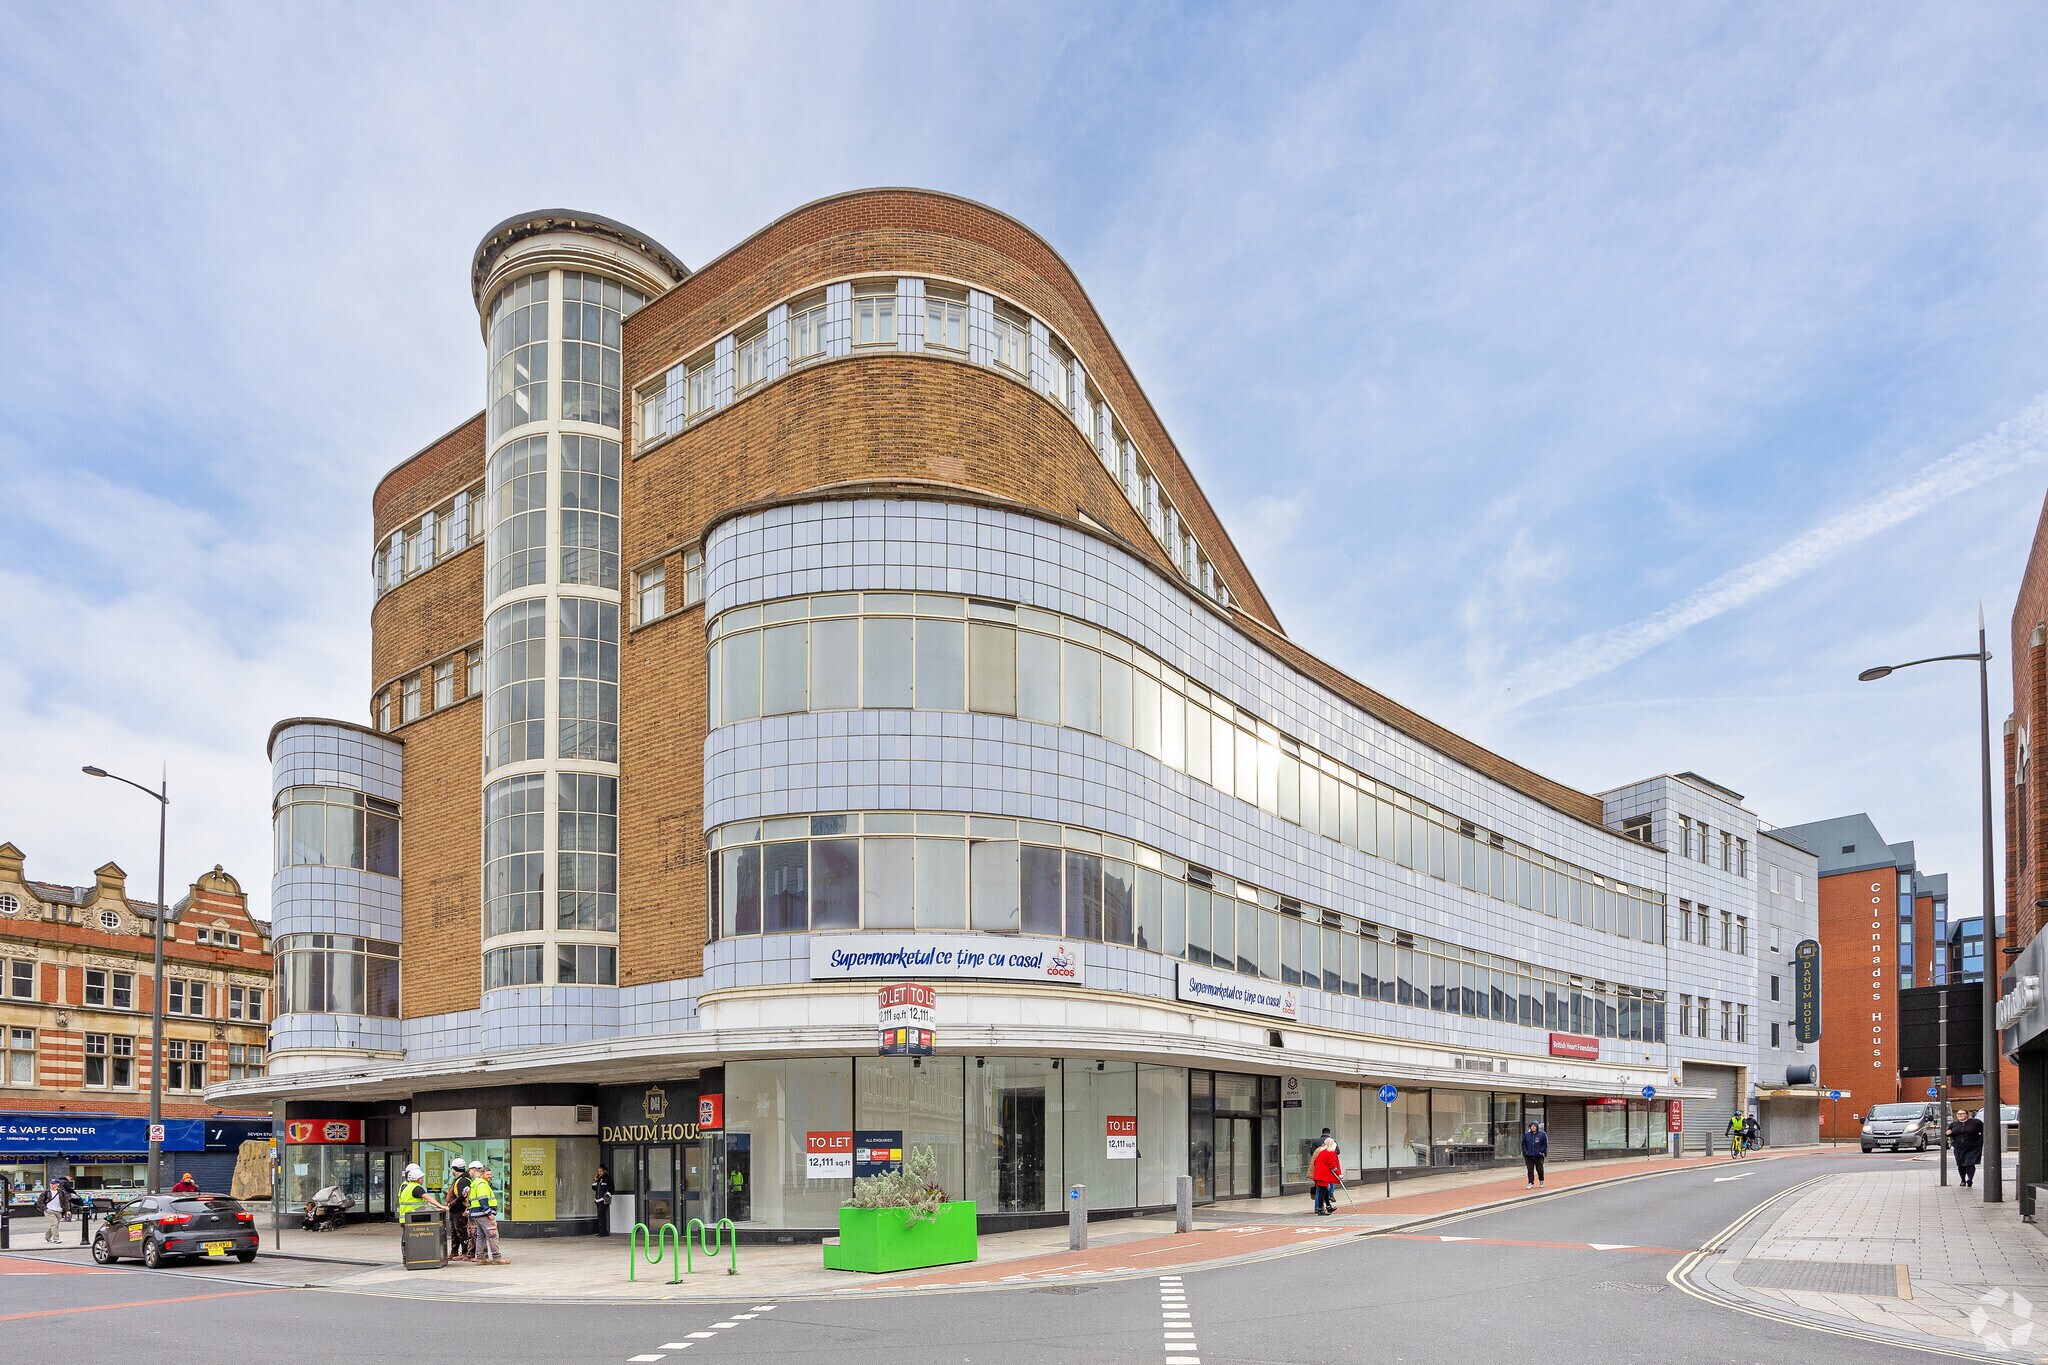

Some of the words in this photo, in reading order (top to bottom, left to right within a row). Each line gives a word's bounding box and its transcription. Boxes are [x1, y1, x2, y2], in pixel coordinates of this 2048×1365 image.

[1870, 882, 1881, 1000] Colonnades
[831, 946, 936, 971] Supermarketul
[936, 951, 953, 965] ce
[957, 949, 985, 970] ține
[988, 952, 1006, 967] cu
[1008, 952, 1043, 969] casa!
[1802, 961, 1812, 999] DANUM
[879, 991, 888, 1006] TO
[889, 987, 907, 1003] LET
[910, 987, 924, 1003] TO
[925, 991, 936, 1006] LE
[1188, 977, 1235, 1001] Supermarketul
[1235, 989, 1243, 999] ce
[1257, 994, 1265, 1004] cu
[1266, 995, 1281, 1008] casa!
[893, 1010, 907, 1022] sq.ft
[910, 1007, 929, 1022] 12,111
[1803, 1002, 1812, 1039] HOUSE
[1553, 1040, 1566, 1049] British
[1566, 1042, 1578, 1051] Heart
[1577, 1043, 1598, 1053] Foundation
[1872, 1012, 1882, 1068] House
[9, 1126, 17, 1134] &
[20, 1126, 48, 1134] VAPE
[50, 1126, 96, 1135] CORNER
[602, 1124, 658, 1142] DANUM
[1108, 1121, 1121, 1131] TO
[1122, 1121, 1135, 1131] LET
[809, 1137, 826, 1148] TO
[829, 1137, 851, 1147] LET
[1108, 1140, 1125, 1149] 12,111
[808, 1158, 834, 1168] 12,111
[835, 1160, 851, 1168] sq.ft
[429, 1169, 439, 1177] FOR
[428, 1177, 440, 1185] RENT
